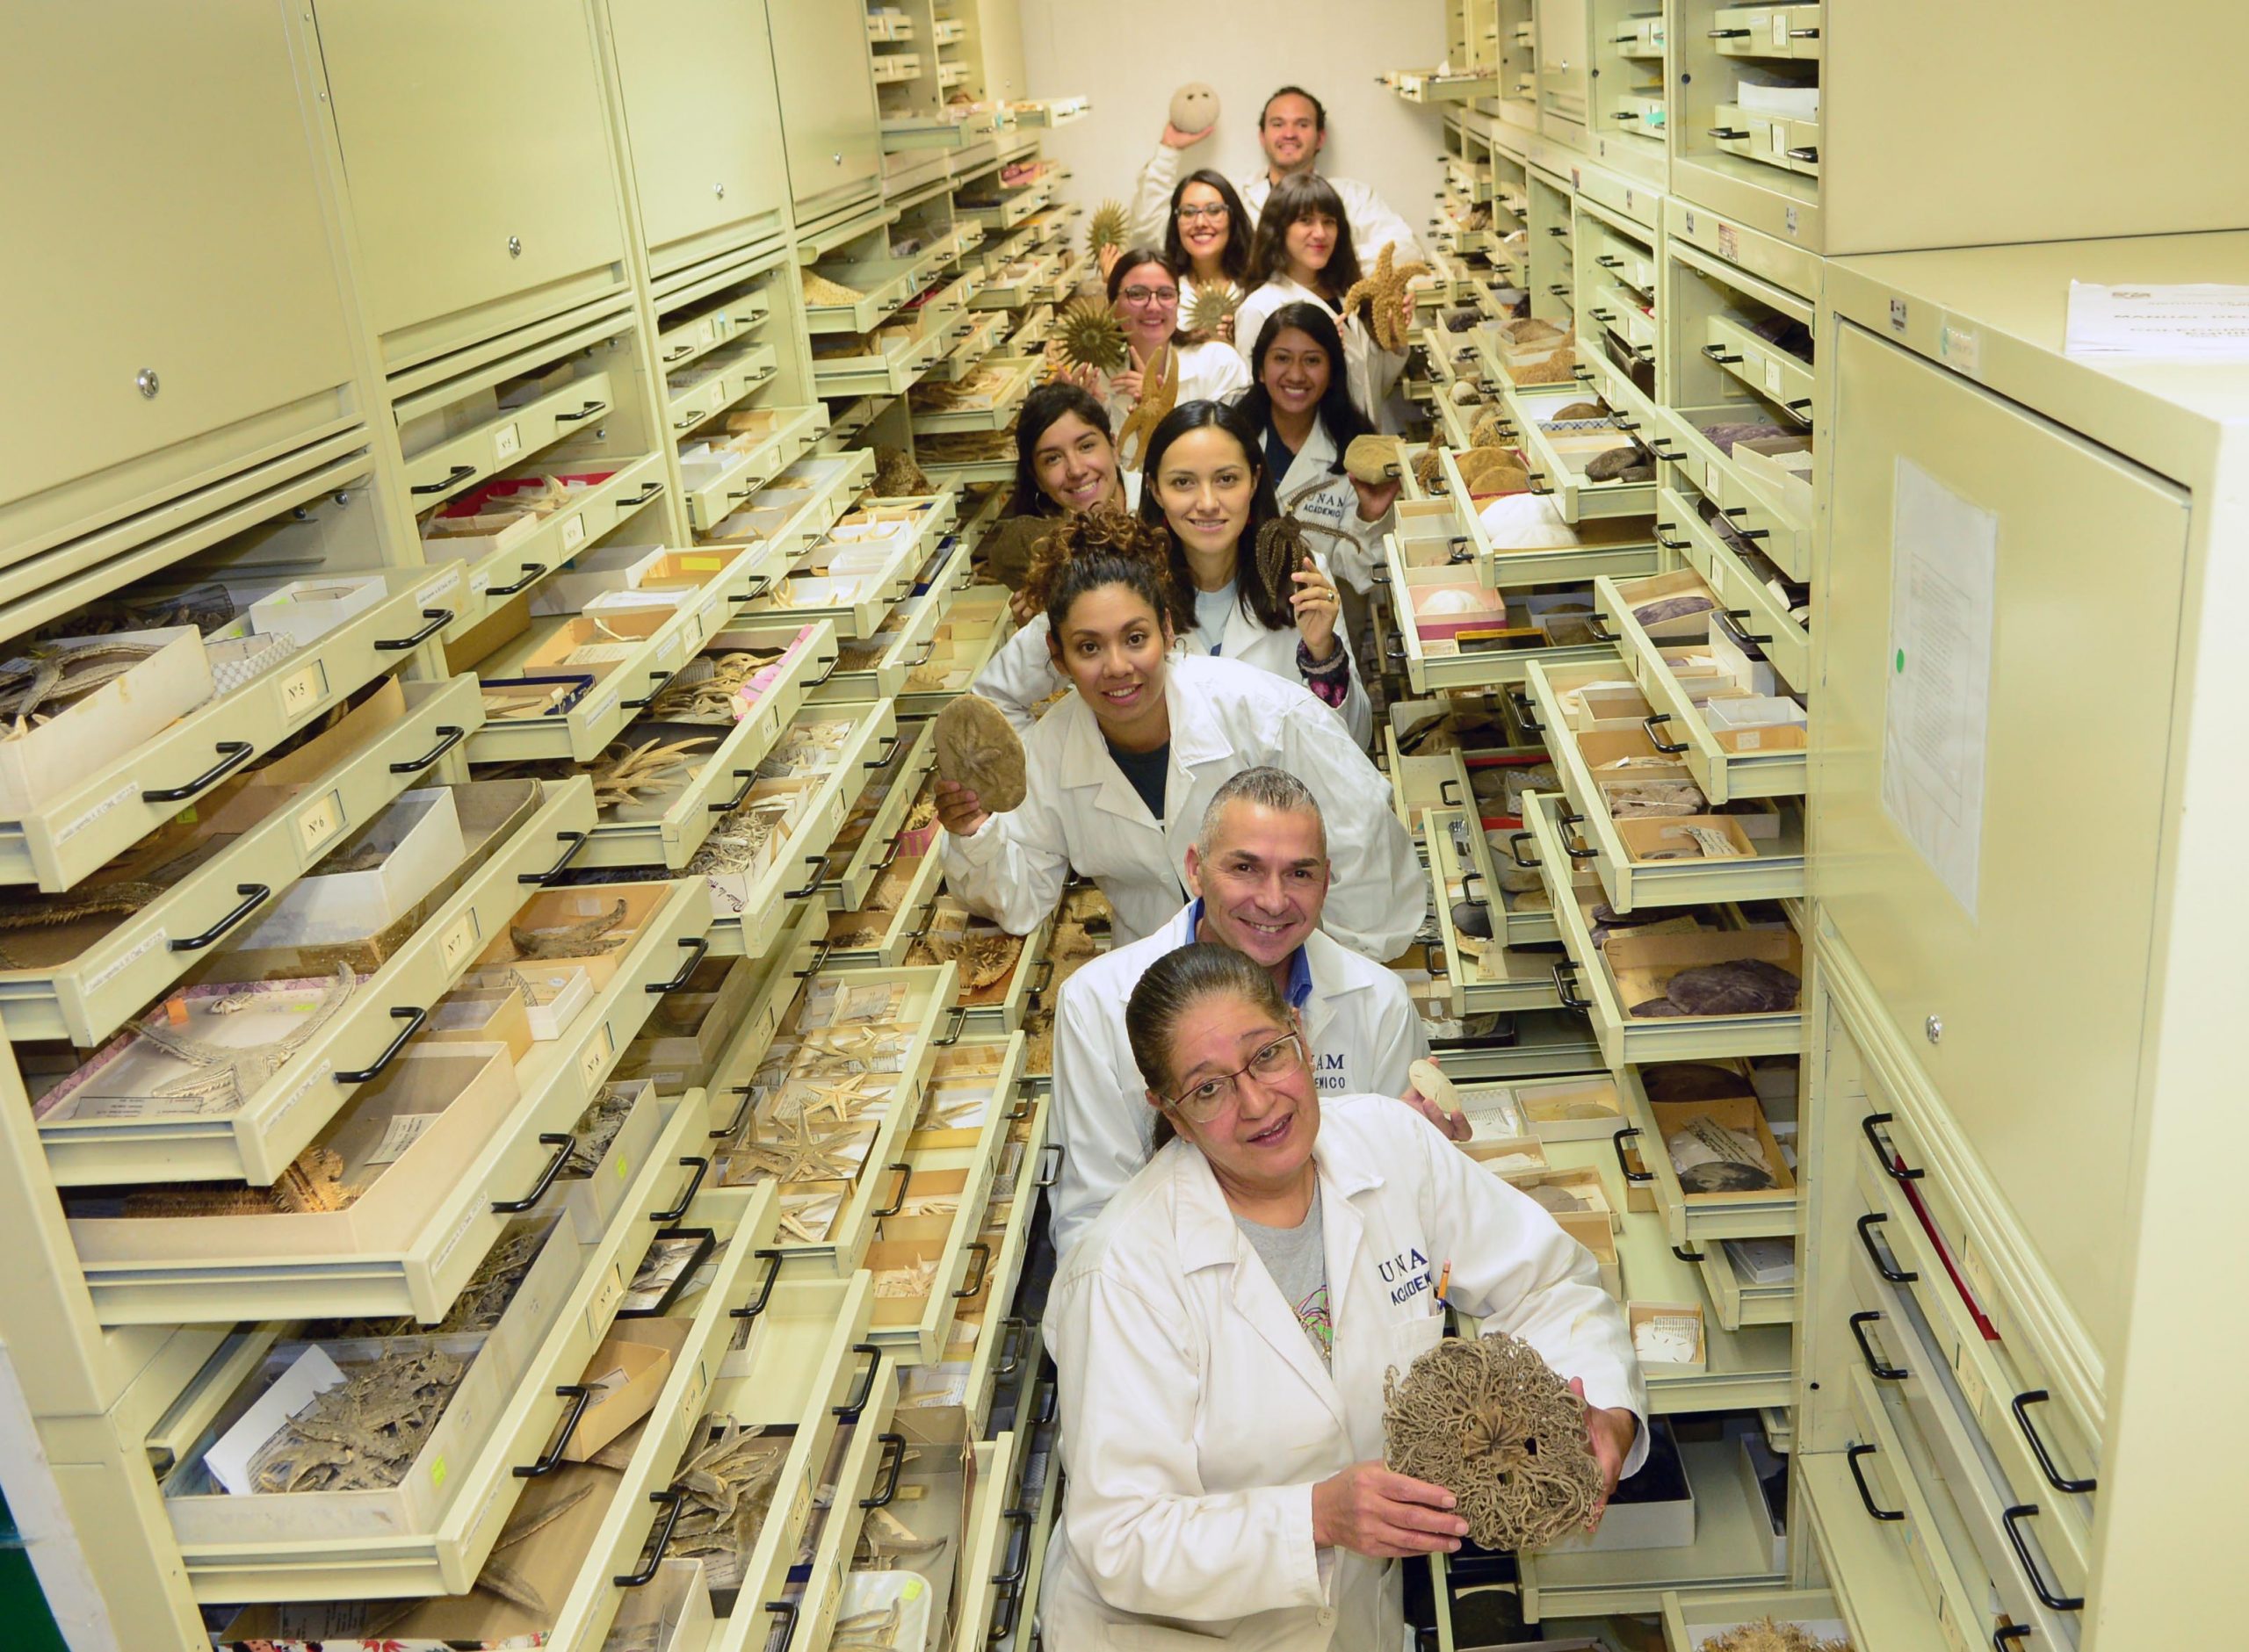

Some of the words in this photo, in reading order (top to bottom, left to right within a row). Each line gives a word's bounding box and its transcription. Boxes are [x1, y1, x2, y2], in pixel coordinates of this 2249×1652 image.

[1303, 503, 1341, 517] ACDEMIC
[300, 682, 305, 696] 5
[319, 814, 324, 827] 6
[456, 934, 461, 947] 7
[1312, 1054, 1345, 1071] AM
[1314, 1077, 1346, 1089] EMICO
[1378, 1248, 1428, 1282] UNA
[1391, 1271, 1434, 1306] ACDEM
